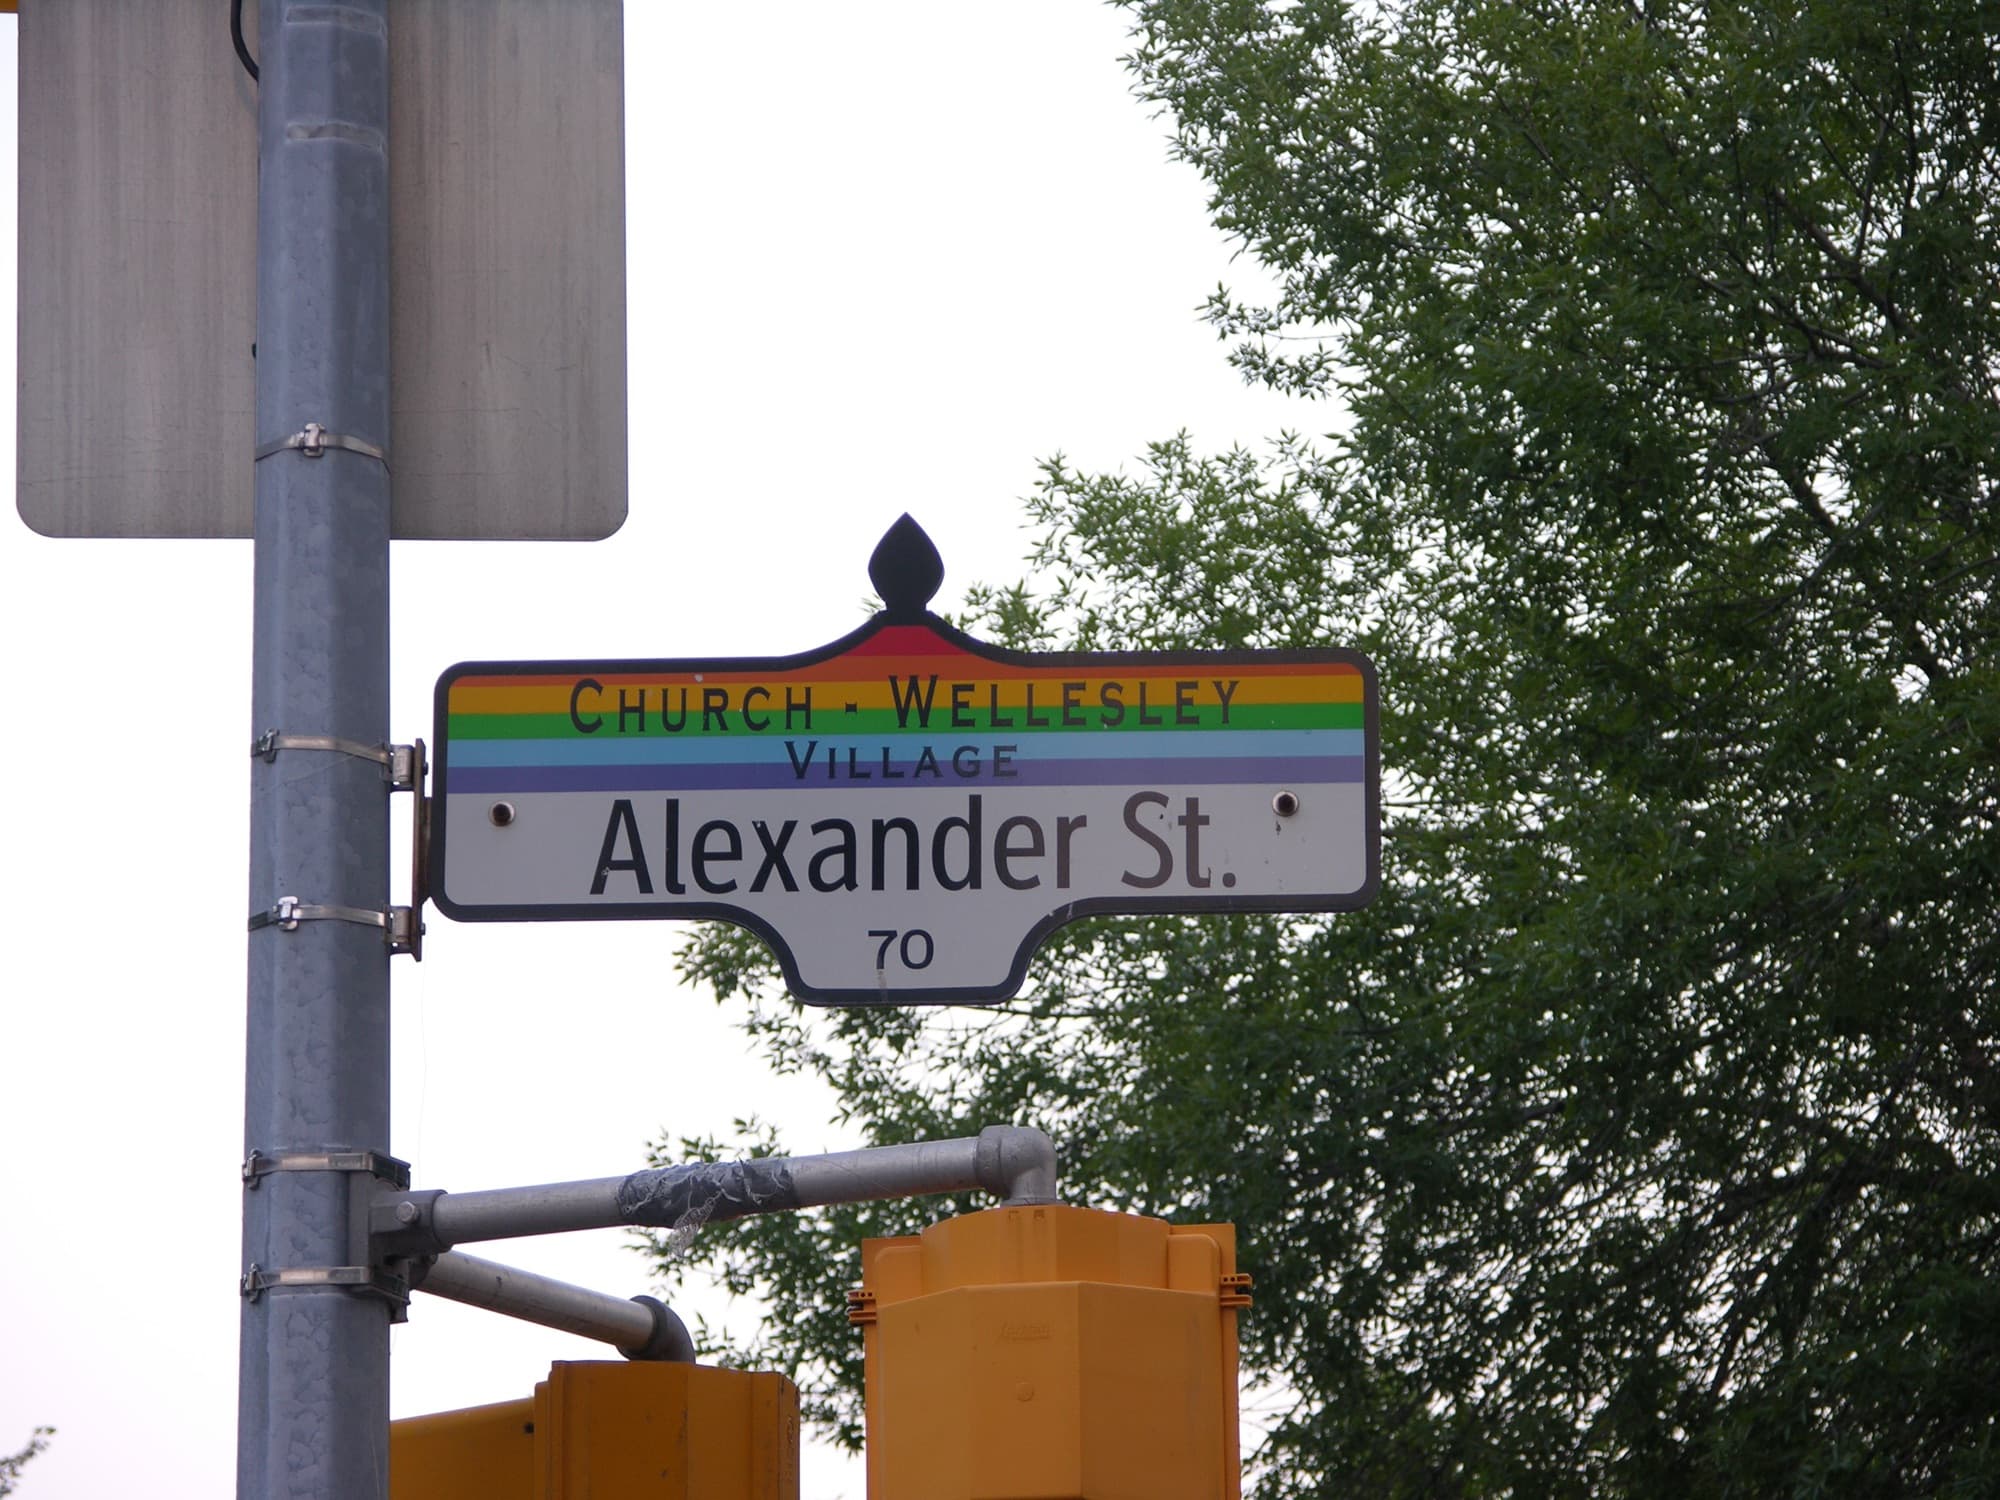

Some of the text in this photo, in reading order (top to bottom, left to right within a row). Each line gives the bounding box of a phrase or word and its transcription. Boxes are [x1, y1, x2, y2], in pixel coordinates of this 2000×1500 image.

[570, 678, 813, 733] CHURCH
[888, 675, 1241, 728] WELLESLEY
[784, 740, 1020, 780] VILLAGE
[589, 790, 1237, 895] Alexander St.
[867, 928, 935, 970] 70
